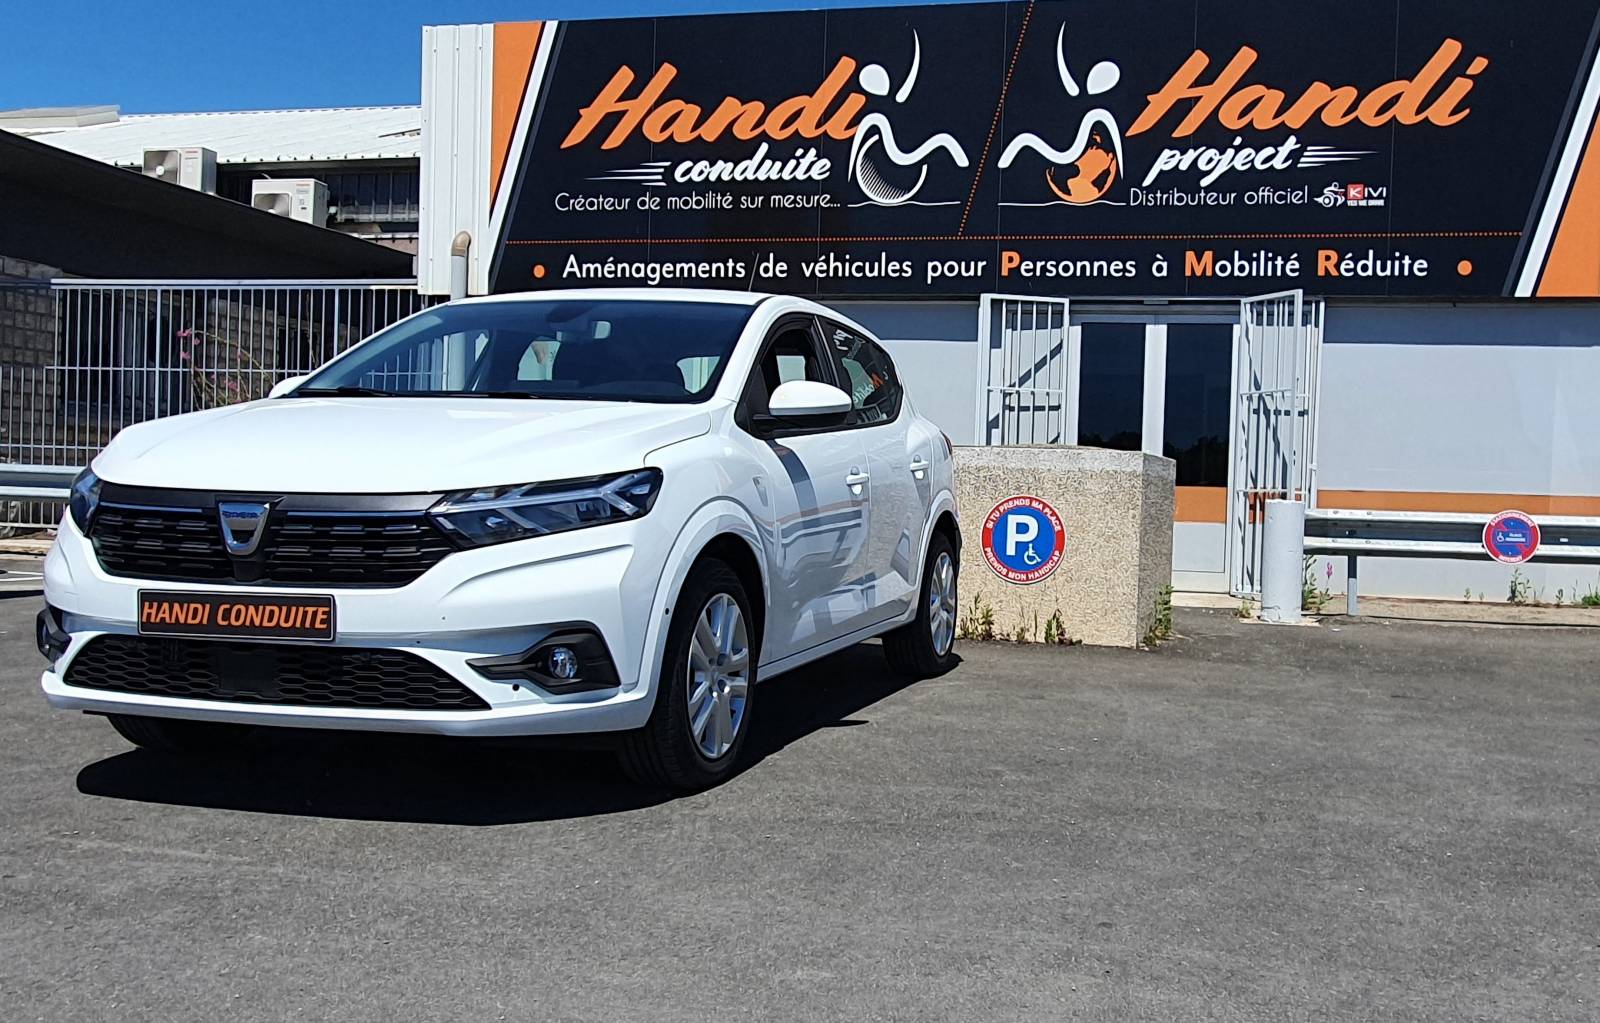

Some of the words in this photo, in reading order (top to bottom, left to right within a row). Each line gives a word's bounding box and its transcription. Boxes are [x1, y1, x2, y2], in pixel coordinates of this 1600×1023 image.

[561, 56, 866, 149] Handi
[1126, 38, 1488, 137] Handi
[675, 142, 831, 183] conduite
[1142, 135, 1302, 187] project
[555, 192, 631, 211] Créateur
[637, 191, 661, 210] de
[667, 190, 733, 210] mobilité
[740, 195, 764, 209] sur
[770, 193, 841, 208] mesure...
[1131, 187, 1237, 207] Distributeur
[1244, 185, 1308, 205] officiel
[1349, 187, 1387, 198] KIVI
[562, 254, 746, 286] Aménagements
[759, 252, 788, 278] de
[801, 251, 912, 278] véhicules
[927, 259, 987, 284] pour
[1001, 250, 1136, 277] Personnes
[1151, 254, 1168, 278] à
[1184, 250, 1300, 277] Mobilité
[1317, 249, 1428, 277] Réduite
[990, 510, 1000, 522] TU
[999, 498, 1031, 513] PRENDS
[1031, 500, 1043, 511] MA
[1043, 508, 1062, 532] PLACE
[1006, 514, 1039, 556] P
[984, 547, 1008, 575] PRENDS
[1007, 571, 1027, 581] MON
[1027, 550, 1061, 580] HANDICAP
[142, 602, 210, 625] HANDI
[216, 604, 330, 629] CONDUITE
